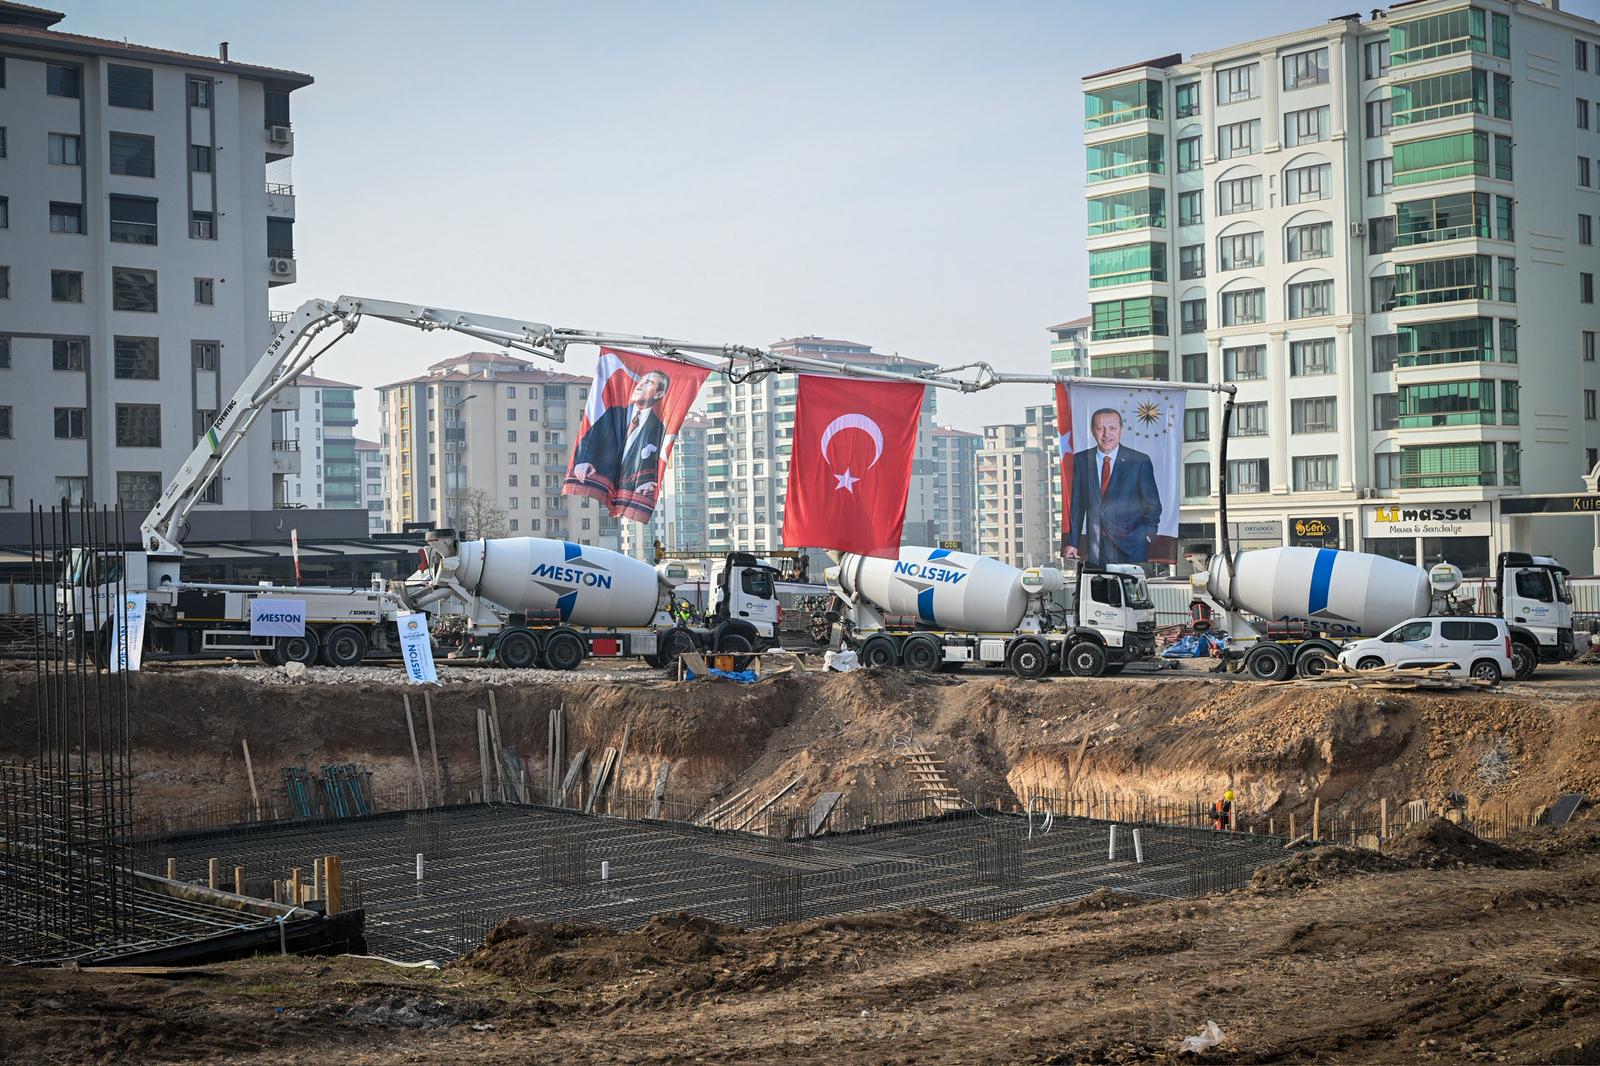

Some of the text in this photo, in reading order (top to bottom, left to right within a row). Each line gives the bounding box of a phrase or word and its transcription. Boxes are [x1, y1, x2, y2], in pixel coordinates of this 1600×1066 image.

[267, 333, 286, 357] S 36 X
[213, 399, 237, 430] SCHWING
[1389, 525, 1412, 533] Masa
[1414, 525, 1420, 533] &
[530, 563, 612, 590] MESTON
[894, 560, 967, 584] MESTON
[257, 613, 301, 623] MESTON
[408, 644, 424, 681] MESTON
